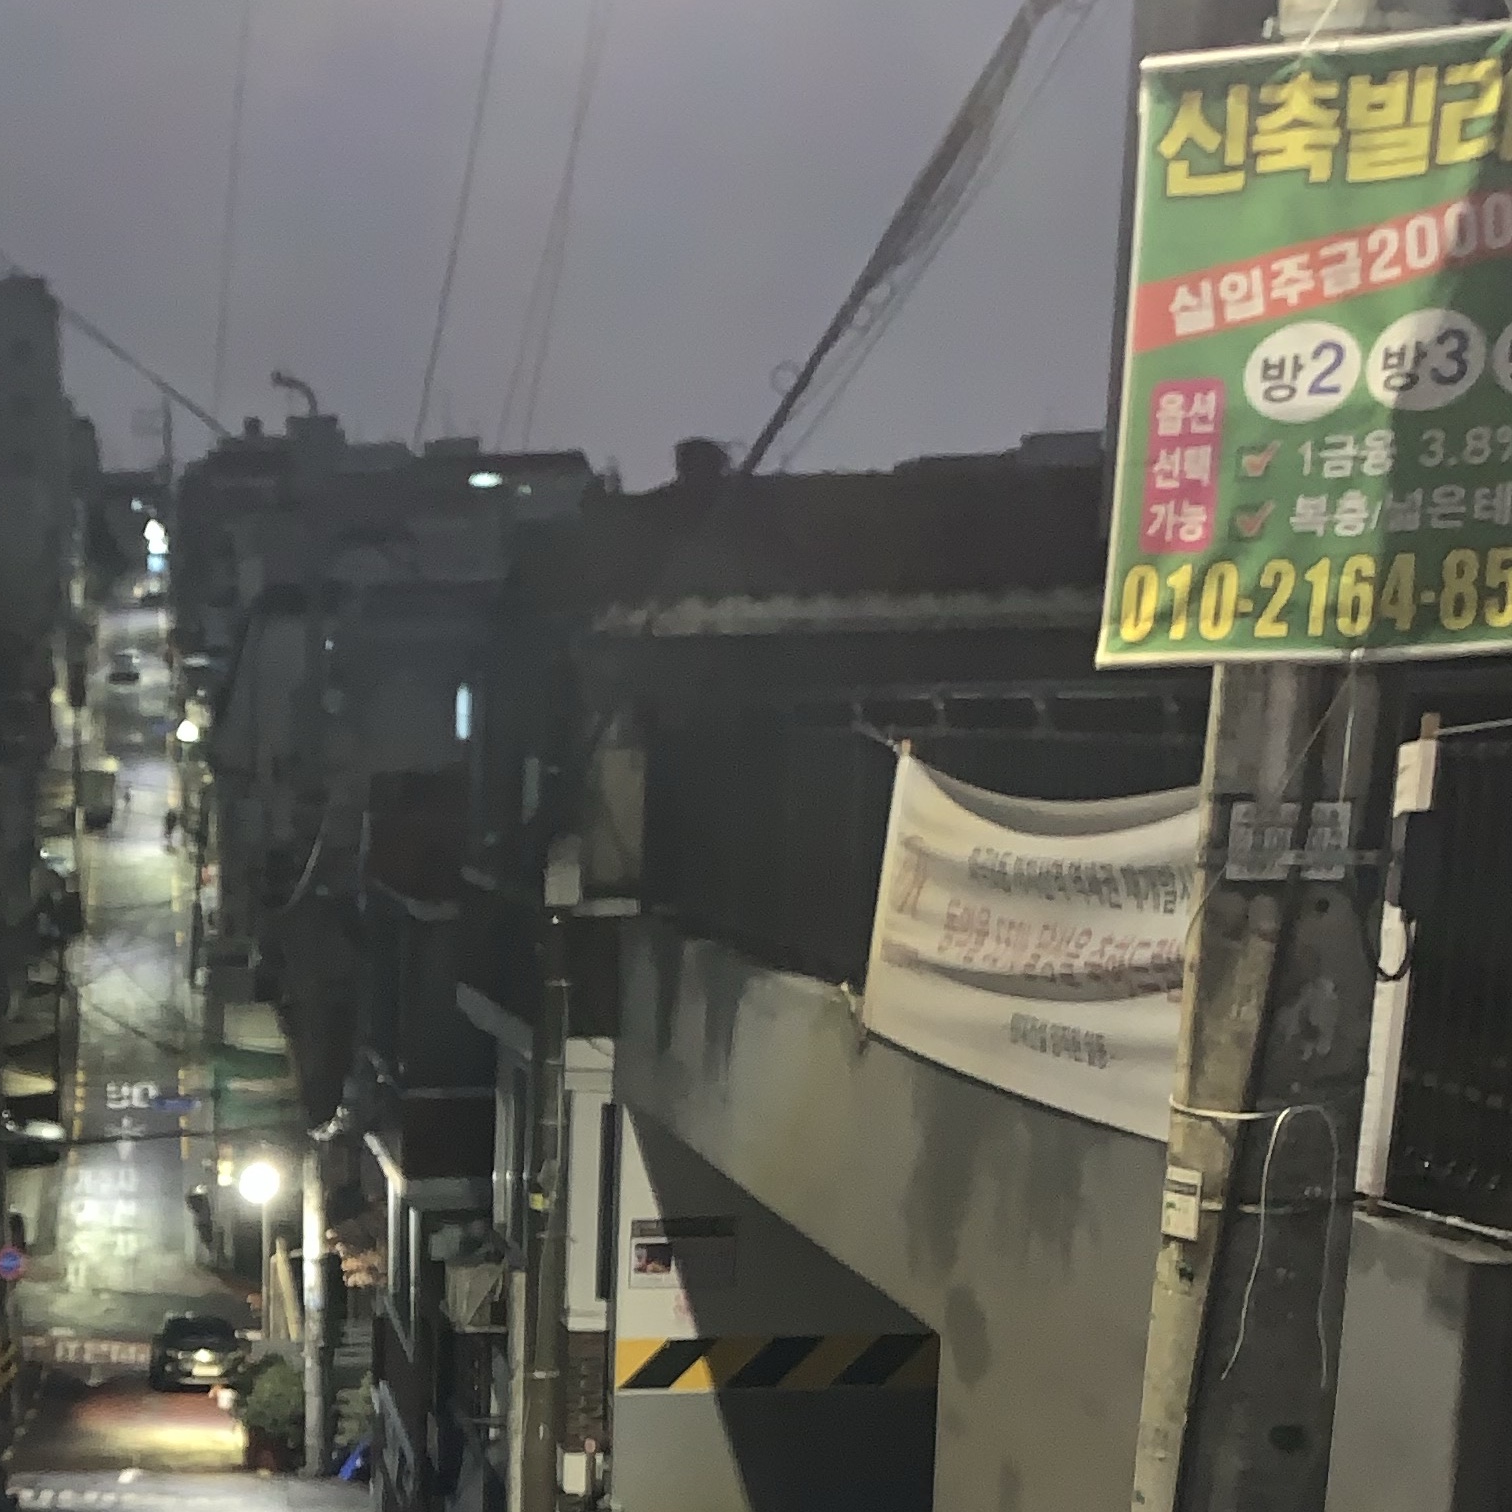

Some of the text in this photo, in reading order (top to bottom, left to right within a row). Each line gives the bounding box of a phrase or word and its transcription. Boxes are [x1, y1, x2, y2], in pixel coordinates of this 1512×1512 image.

[1260, 339, 1347, 403] 방2
[1381, 328, 1471, 393] 방3
[1155, 390, 1217, 437] 옵션
[1146, 499, 1208, 543] 가능
[1118, 547, 1512, 644] 010-2164-85
